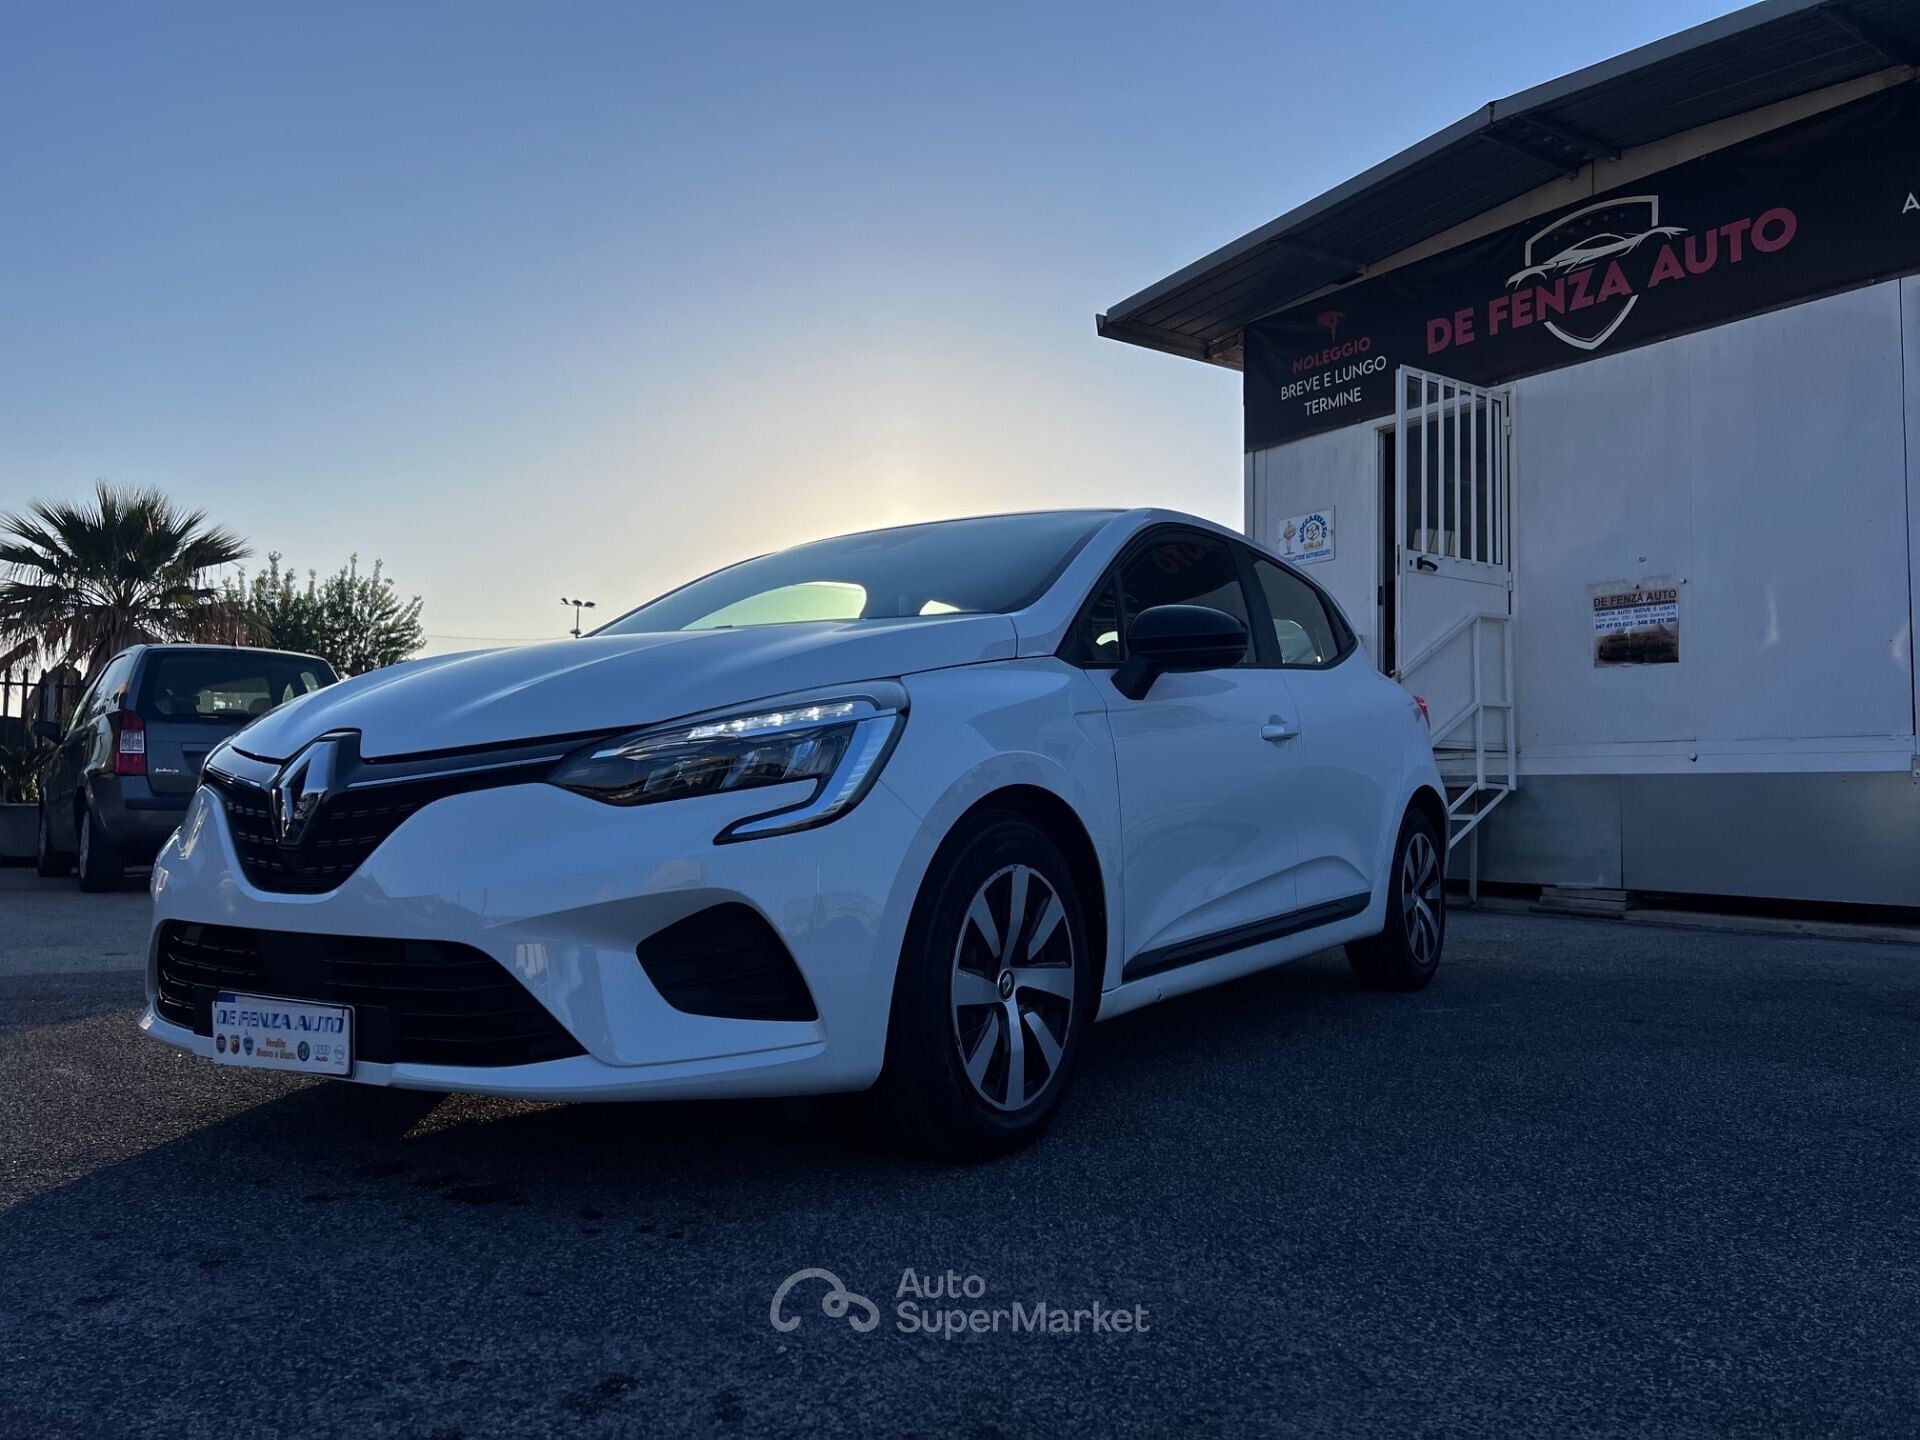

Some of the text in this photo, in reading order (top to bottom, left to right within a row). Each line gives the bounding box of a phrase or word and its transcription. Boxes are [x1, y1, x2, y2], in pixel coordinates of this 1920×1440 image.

[1426, 207, 1797, 354] DE FENZA AUTO
[1292, 336, 1371, 374] NOLEGGIO
[1281, 355, 1387, 400] BREVE E LUNGO
[1304, 387, 1362, 416] TERMINE
[1593, 590, 1676, 607] DE FENZA AUTO
[217, 1009, 344, 1033] DE FENZA AUTO
